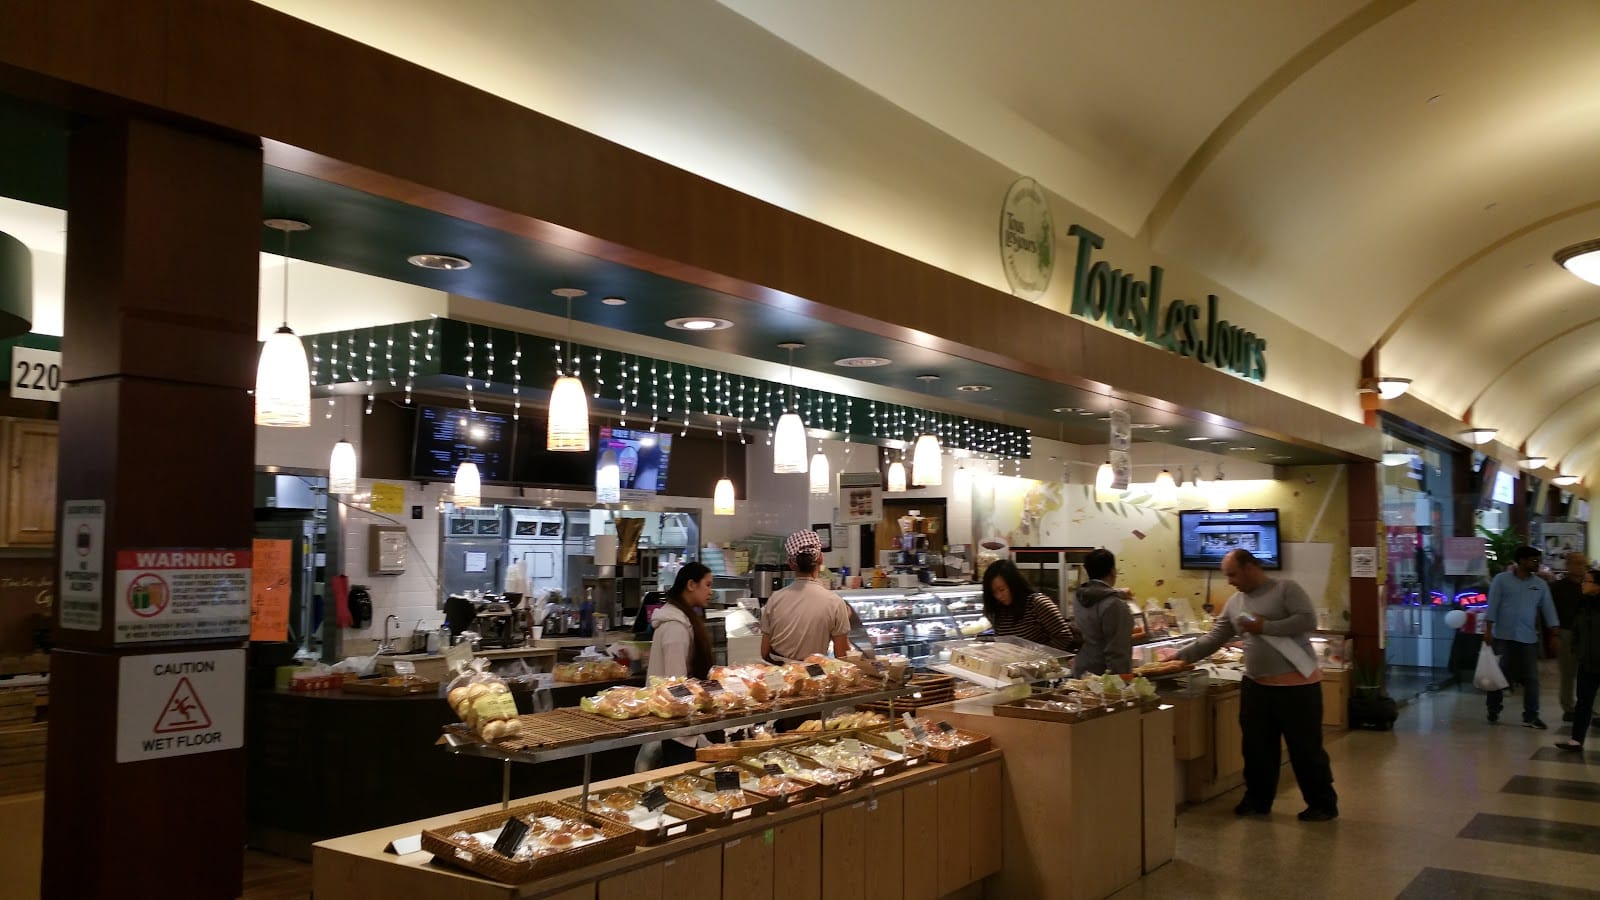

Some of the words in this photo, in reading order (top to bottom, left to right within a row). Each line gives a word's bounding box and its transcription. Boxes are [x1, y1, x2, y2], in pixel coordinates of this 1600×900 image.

[1067, 225, 1148, 337] Tous
[1145, 265, 1201, 358] Les
[1198, 294, 1268, 382] Jours
[16, 361, 61, 391] 220
[135, 552, 237, 568] WARNING
[153, 660, 215, 677] CAUTION
[142, 738, 172, 752] WET
[177, 732, 223, 749] FLOOR
